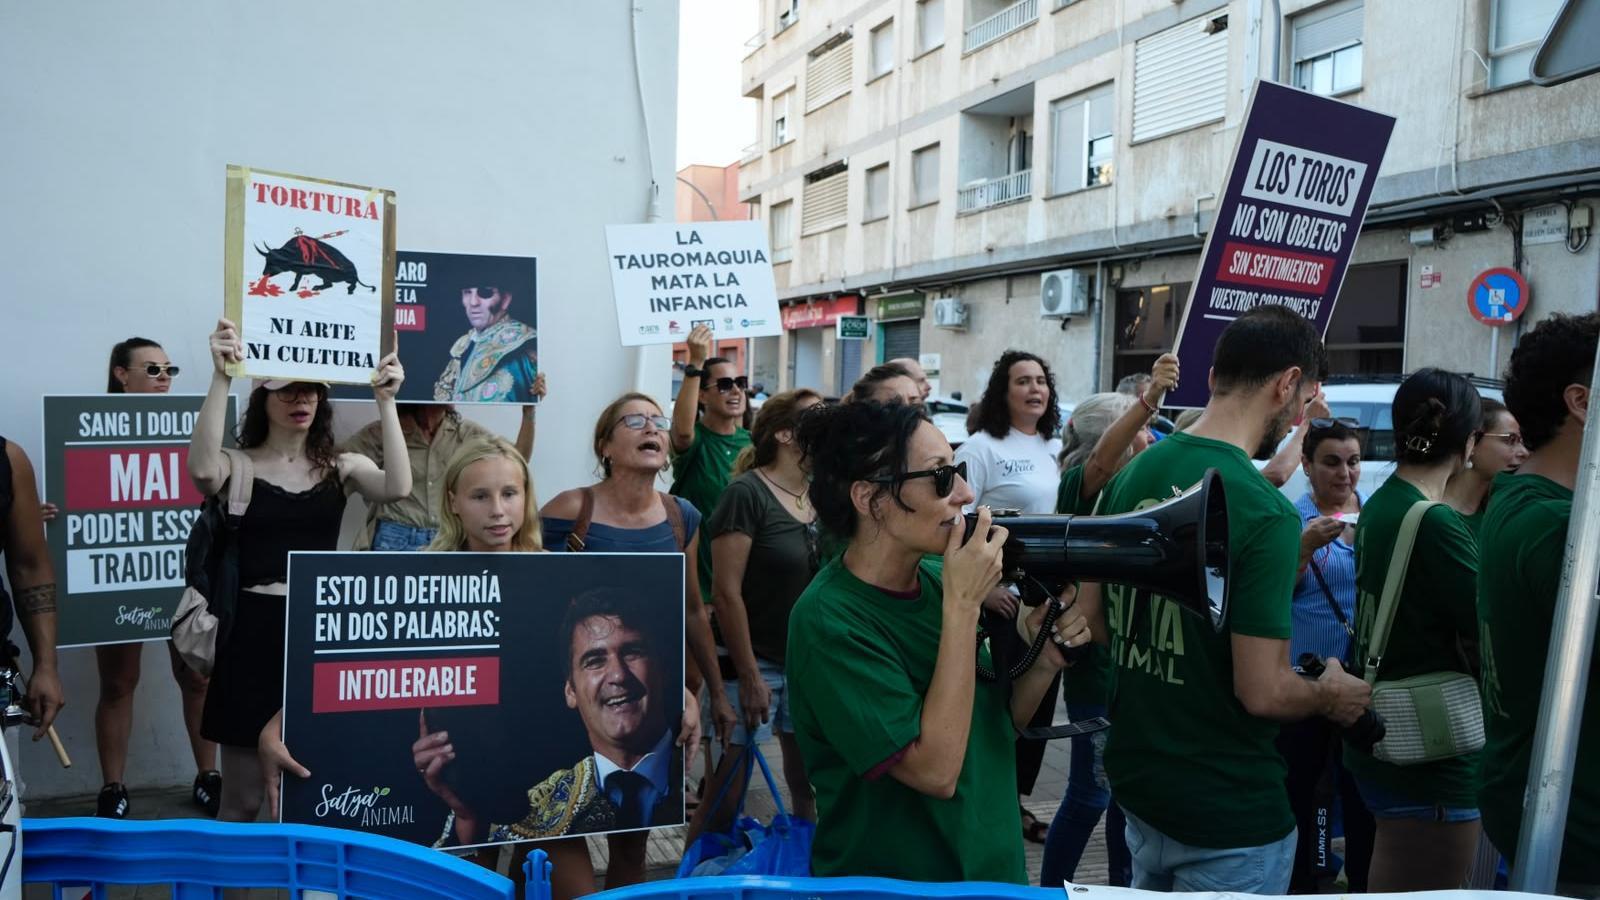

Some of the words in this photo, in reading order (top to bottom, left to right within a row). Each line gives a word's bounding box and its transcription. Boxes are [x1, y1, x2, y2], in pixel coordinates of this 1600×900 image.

[1254, 148, 1297, 195] LOS
[1295, 157, 1356, 207] TOROS
[253, 182, 379, 220] TORTURA
[676, 230, 703, 245] LA
[1230, 202, 1257, 238] NO
[1254, 207, 1289, 244] SON
[1286, 213, 1347, 253] OBJETOS
[394, 261, 427, 282] ARO
[614, 249, 768, 270] TAUROMAQUIA
[1229, 250, 1252, 276] SIN
[1250, 253, 1324, 286] SENTIMIENTOS
[651, 273, 708, 290] MATA
[713, 272, 740, 287] LA
[404, 288, 417, 303] LA
[650, 293, 748, 313] INFANCIA
[1209, 287, 1257, 312] VUESTROS
[1308, 296, 1323, 320] SÍ
[270, 317, 293, 335] NI
[300, 321, 356, 341] ARTE
[394, 308, 416, 326] UIA
[246, 342, 270, 360] NI
[277, 344, 375, 369] CULTURA
[78, 411, 131, 437] SANG
[136, 411, 141, 436] I
[110, 452, 180, 502] MAI
[67, 511, 144, 546] PODEN
[315, 575, 367, 606] ESTO
[373, 575, 398, 605] LO
[404, 569, 502, 604] DEFINIRÍA
[115, 604, 155, 626] Satya
[315, 612, 342, 642] EN
[348, 611, 388, 641] DOS
[394, 609, 500, 640] PALABRAS:
[338, 665, 478, 701] INTOLERABLE
[315, 783, 380, 818] Satya
[360, 805, 415, 827] ANIMAL
[1317, 808, 1327, 826] S5
[1317, 828, 1326, 867] LUMIX
